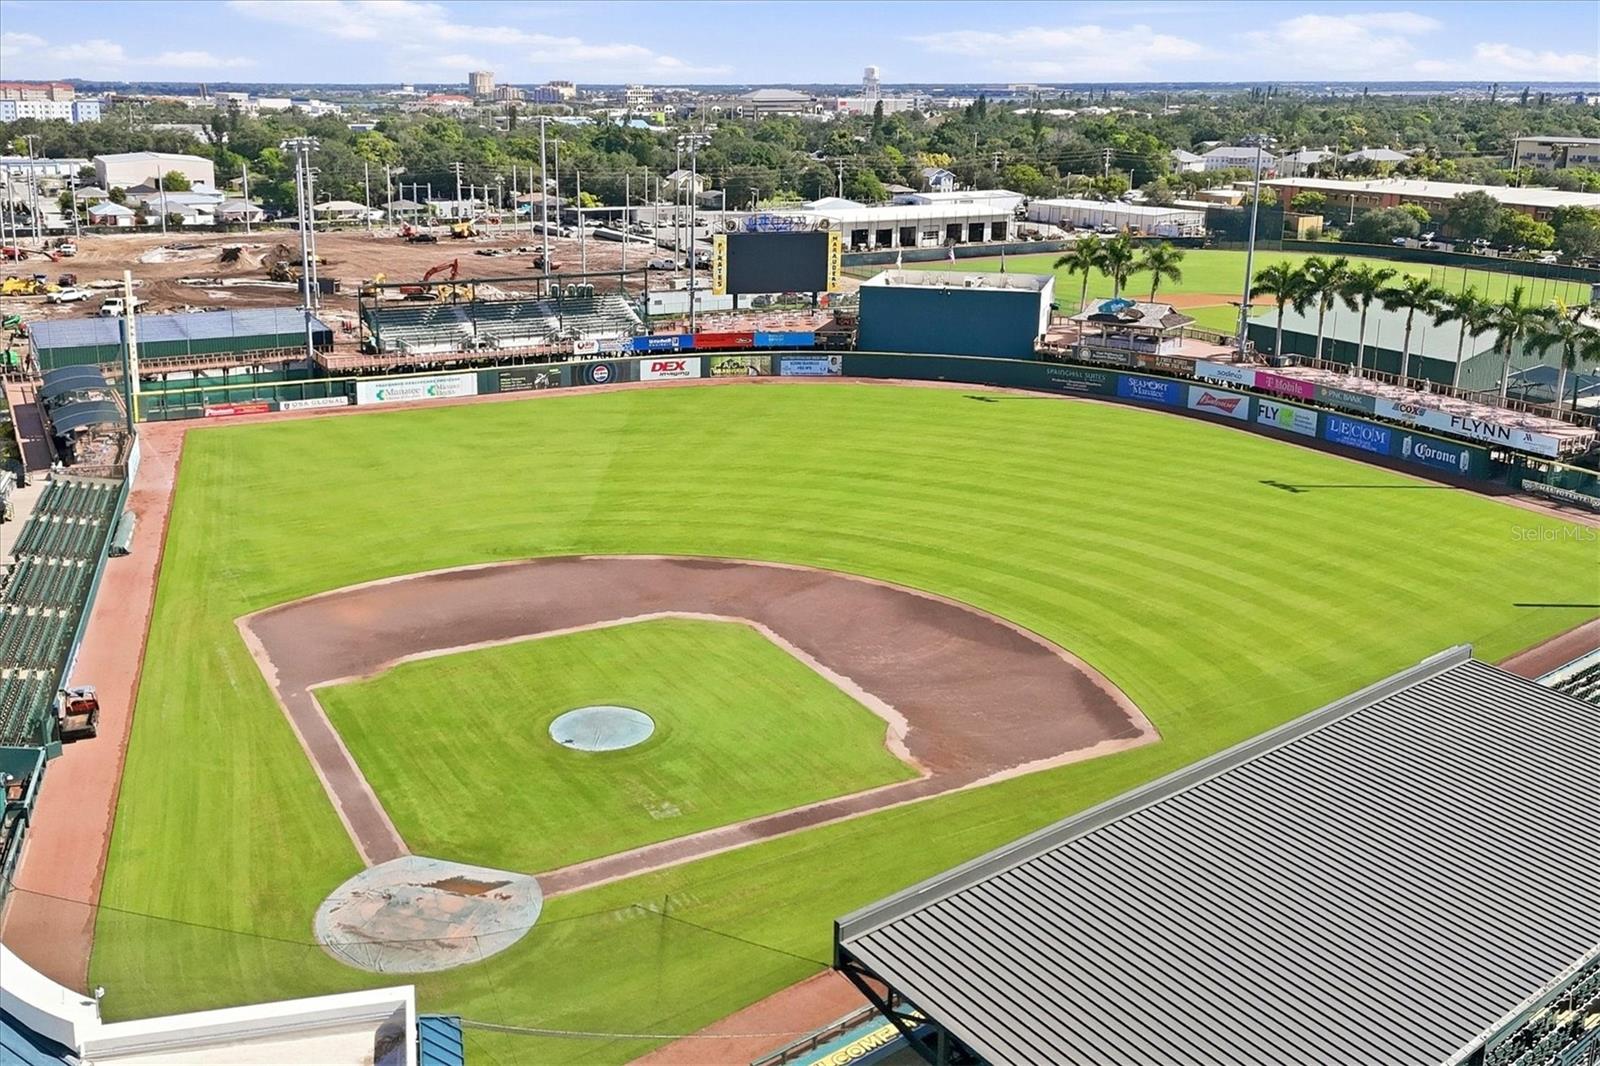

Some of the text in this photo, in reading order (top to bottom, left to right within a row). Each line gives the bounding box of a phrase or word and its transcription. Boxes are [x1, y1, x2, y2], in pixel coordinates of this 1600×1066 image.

[651, 360, 687, 373] DEX
[1046, 368, 1106, 381] SPRINGHILL SUITES
[1128, 377, 1168, 391] SEAPORT
[1275, 379, 1303, 394] Mobile
[311, 398, 346, 406] GLOBAL
[1344, 393, 1362, 404] BANK
[1259, 404, 1279, 421] FLY
[1400, 404, 1420, 416] COX
[1451, 415, 1511, 441] FLYNN
[1414, 442, 1457, 466] Corona
